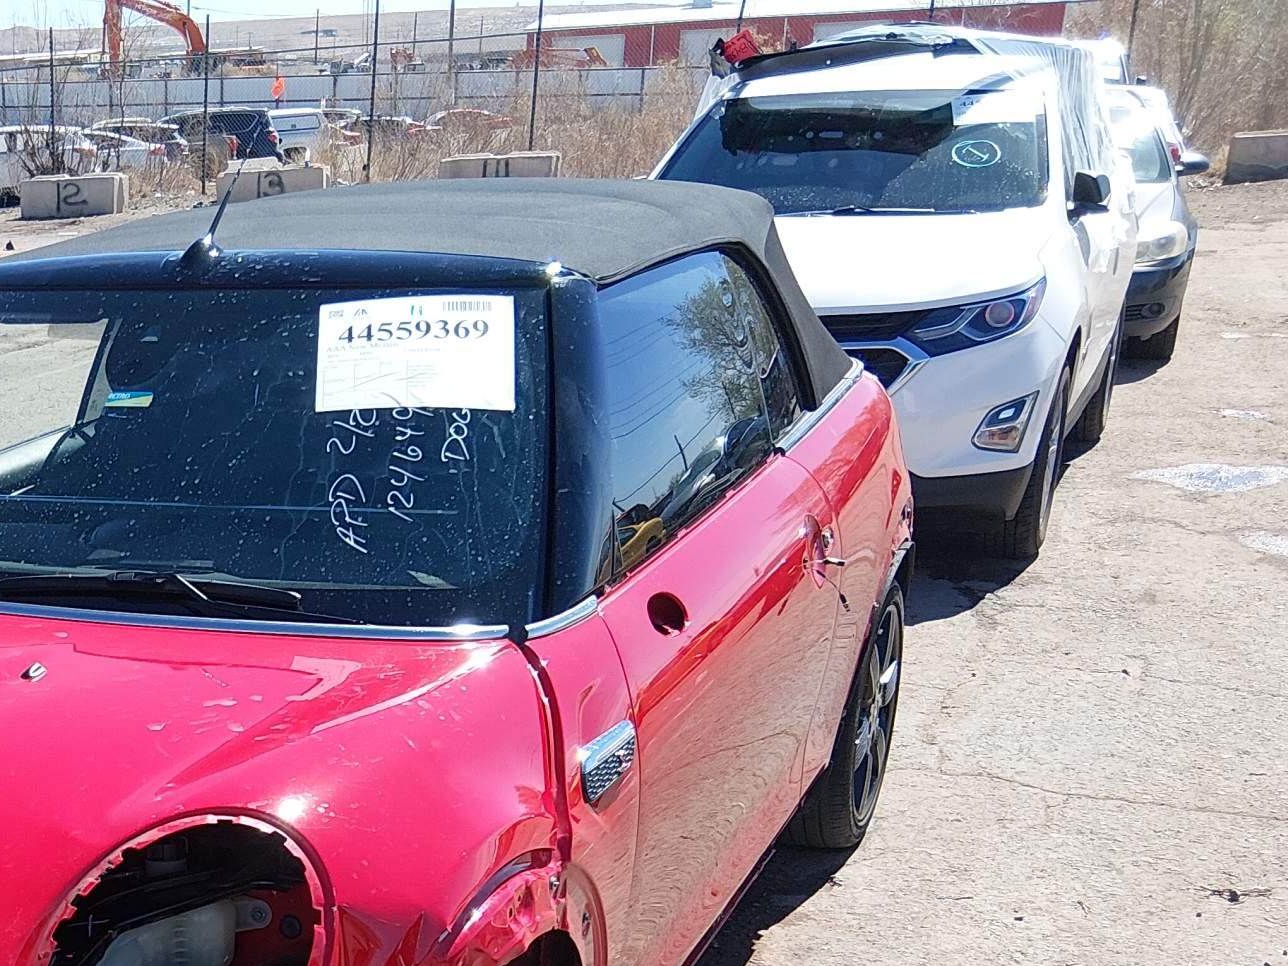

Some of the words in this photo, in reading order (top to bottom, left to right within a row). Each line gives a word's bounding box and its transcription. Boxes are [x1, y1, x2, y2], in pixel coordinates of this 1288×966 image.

[55, 182, 88, 213] 12
[256, 172, 285, 198] 13
[339, 318, 489, 344] 44559369
[328, 474, 368, 554] APD
